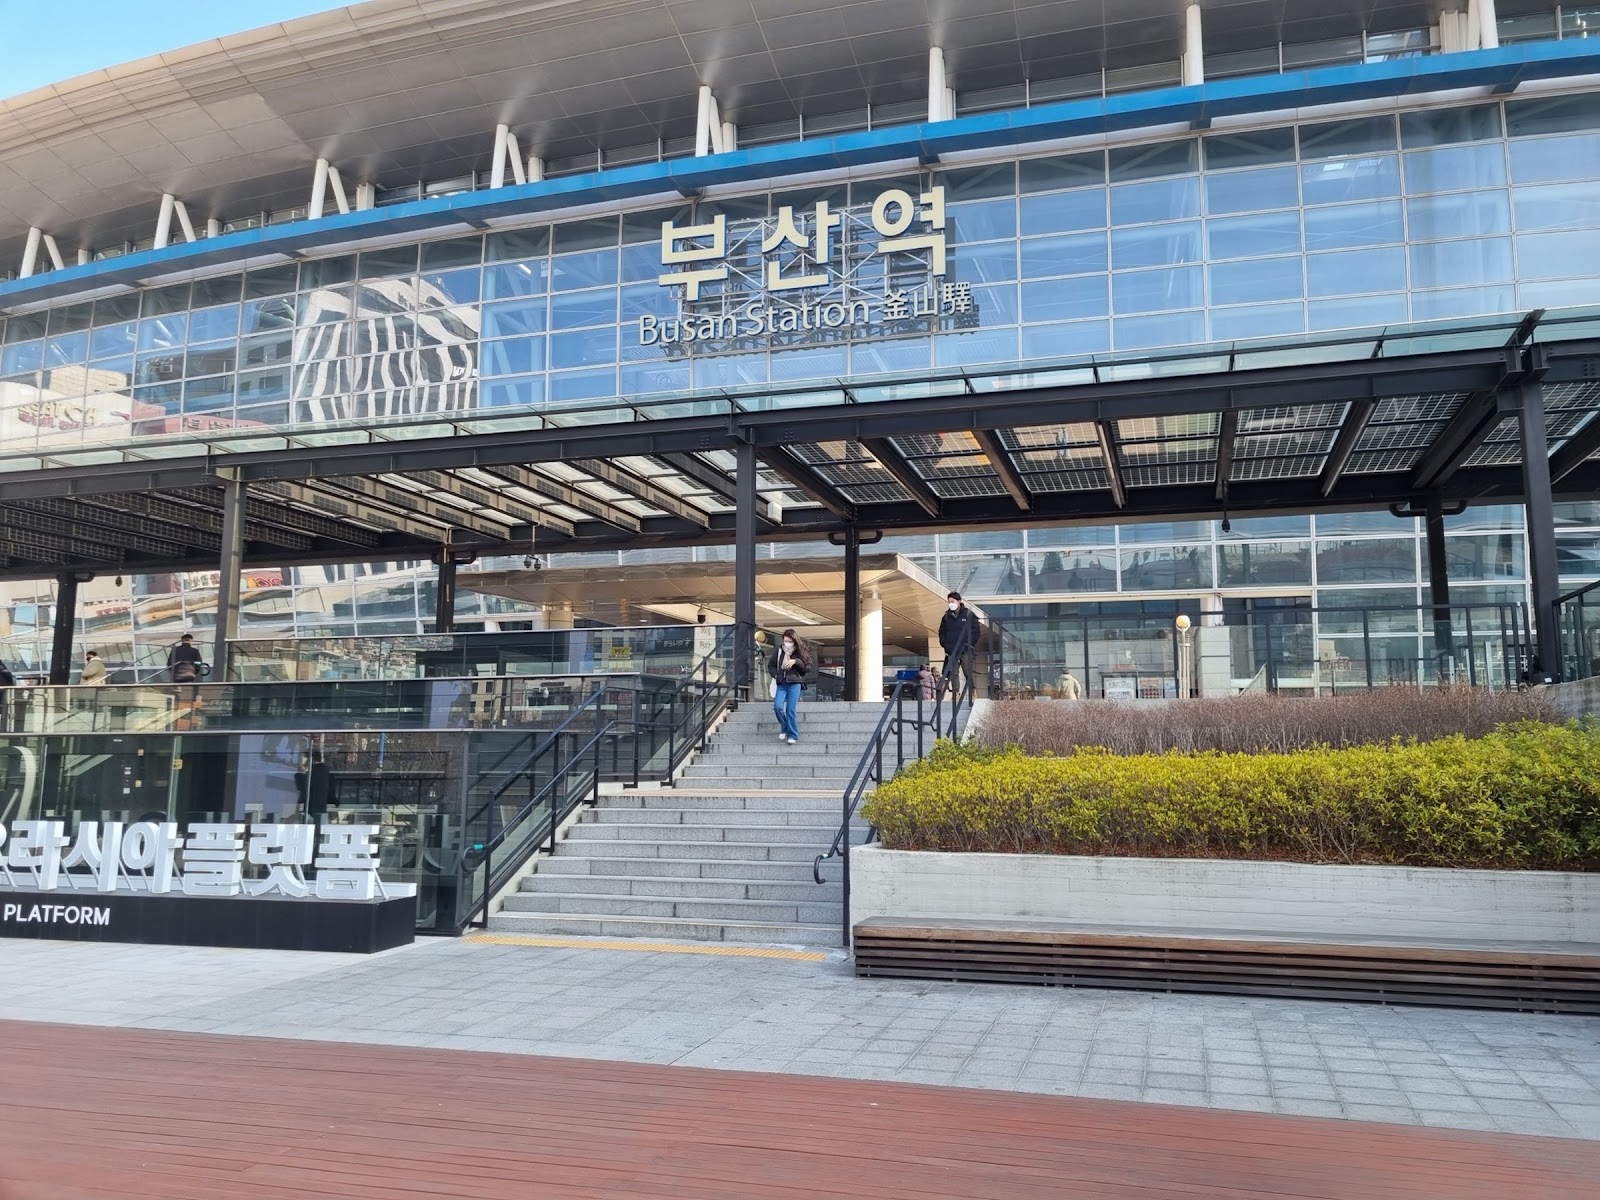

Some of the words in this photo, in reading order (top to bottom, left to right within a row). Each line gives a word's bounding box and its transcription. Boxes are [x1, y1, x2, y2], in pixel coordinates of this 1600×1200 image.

[659, 186, 947, 300] 부산역
[639, 313, 738, 346] Busan
[746, 298, 870, 336] Station
[883, 281, 972, 322] 釜山驛
[3, 904, 111, 926] PLATFORM
